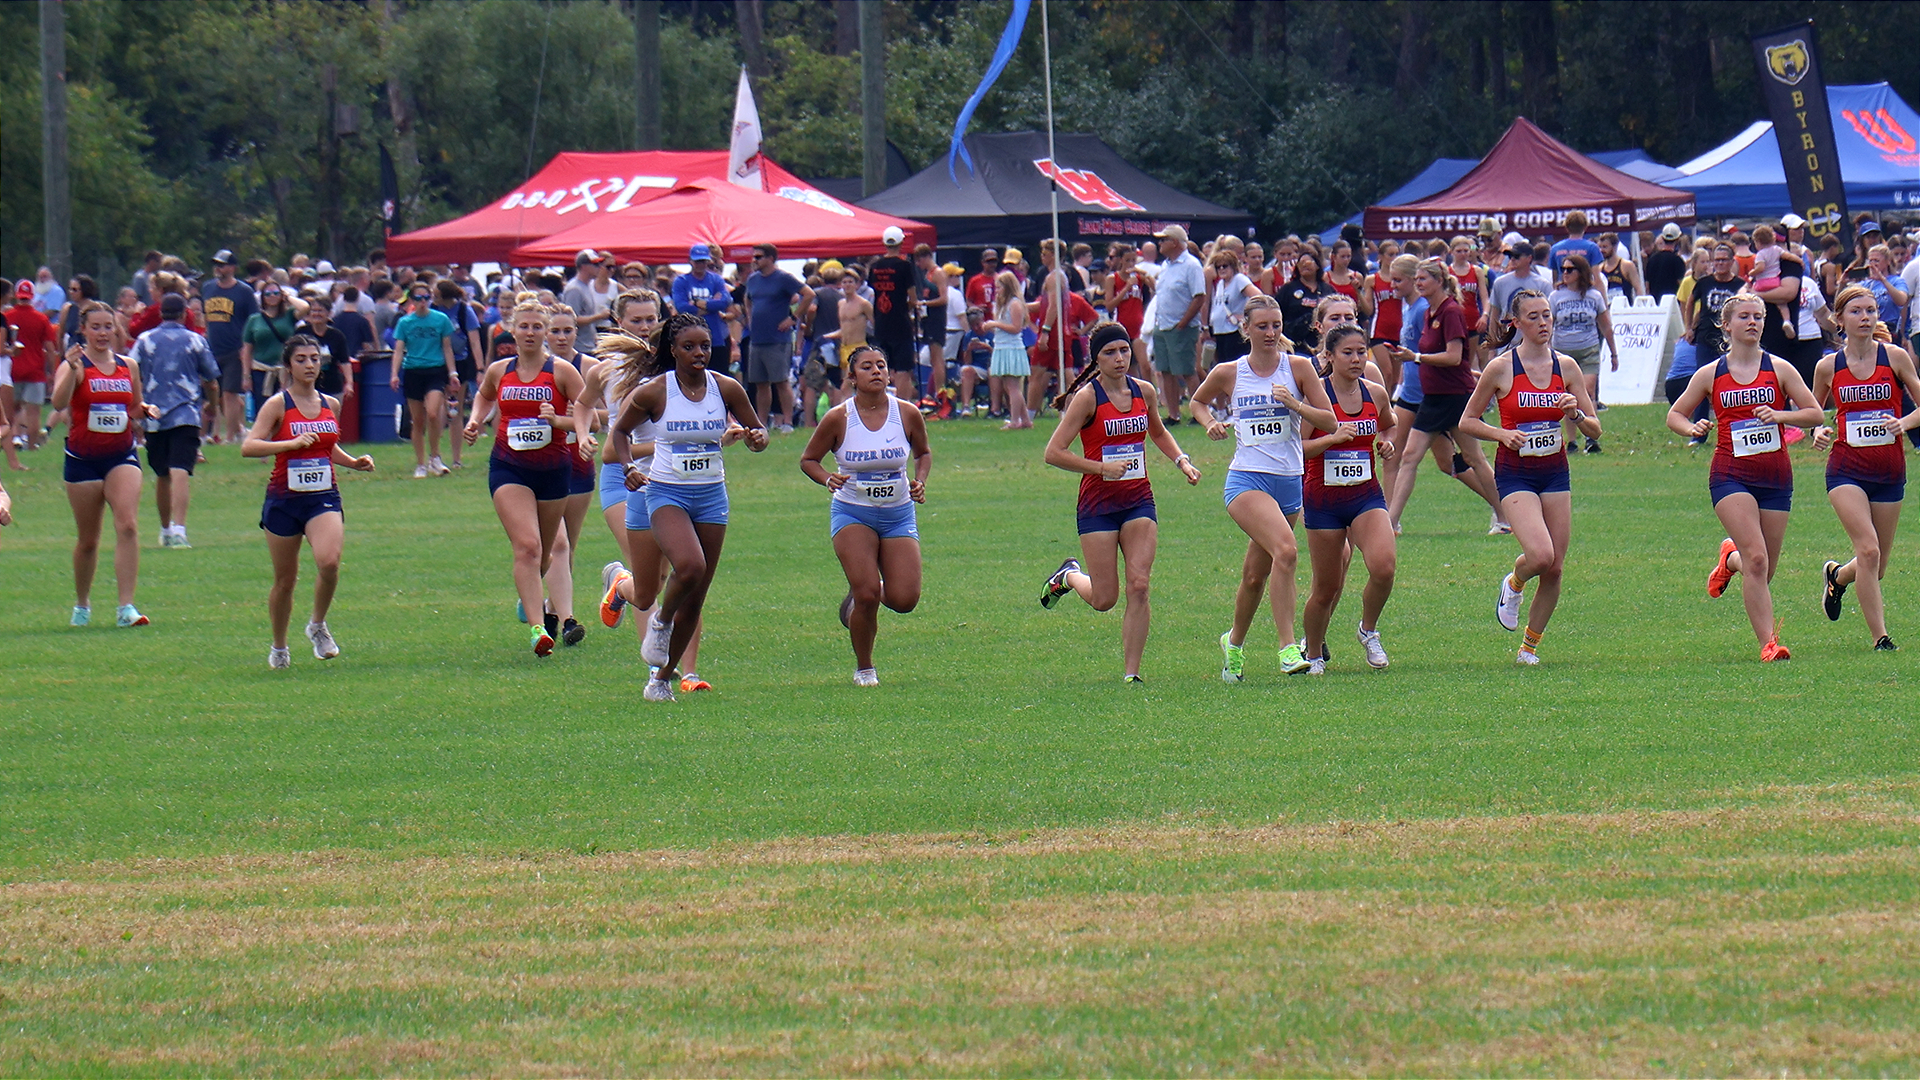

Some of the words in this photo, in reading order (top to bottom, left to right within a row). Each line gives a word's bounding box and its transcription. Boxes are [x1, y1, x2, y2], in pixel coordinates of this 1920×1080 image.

[1791, 90, 1825, 193] BYRON
[1387, 214, 1508, 233] CHATFIED
[1513, 208, 1614, 230] GOPHRS
[1806, 203, 1842, 238] CC
[1622, 336, 1653, 349] STAND
[501, 385, 553, 402] VITERBO
[1237, 394, 1268, 407] UPPER
[1719, 386, 1776, 409] VITERBO
[1838, 382, 1892, 404] VITERBO
[96, 416, 121, 426] 1661
[666, 420, 700, 432] UPPER
[514, 430, 544, 443] 1662
[1249, 422, 1282, 437] 1649
[1856, 426, 1887, 439] 1665
[1527, 434, 1556, 450] 1663
[1741, 431, 1772, 447] 1660
[844, 449, 879, 462] UPPER
[881, 446, 907, 459] IOWA
[682, 457, 711, 472] 1651
[1333, 465, 1363, 478] 1659
[297, 471, 324, 484] 1697
[865, 485, 896, 498] 1652
